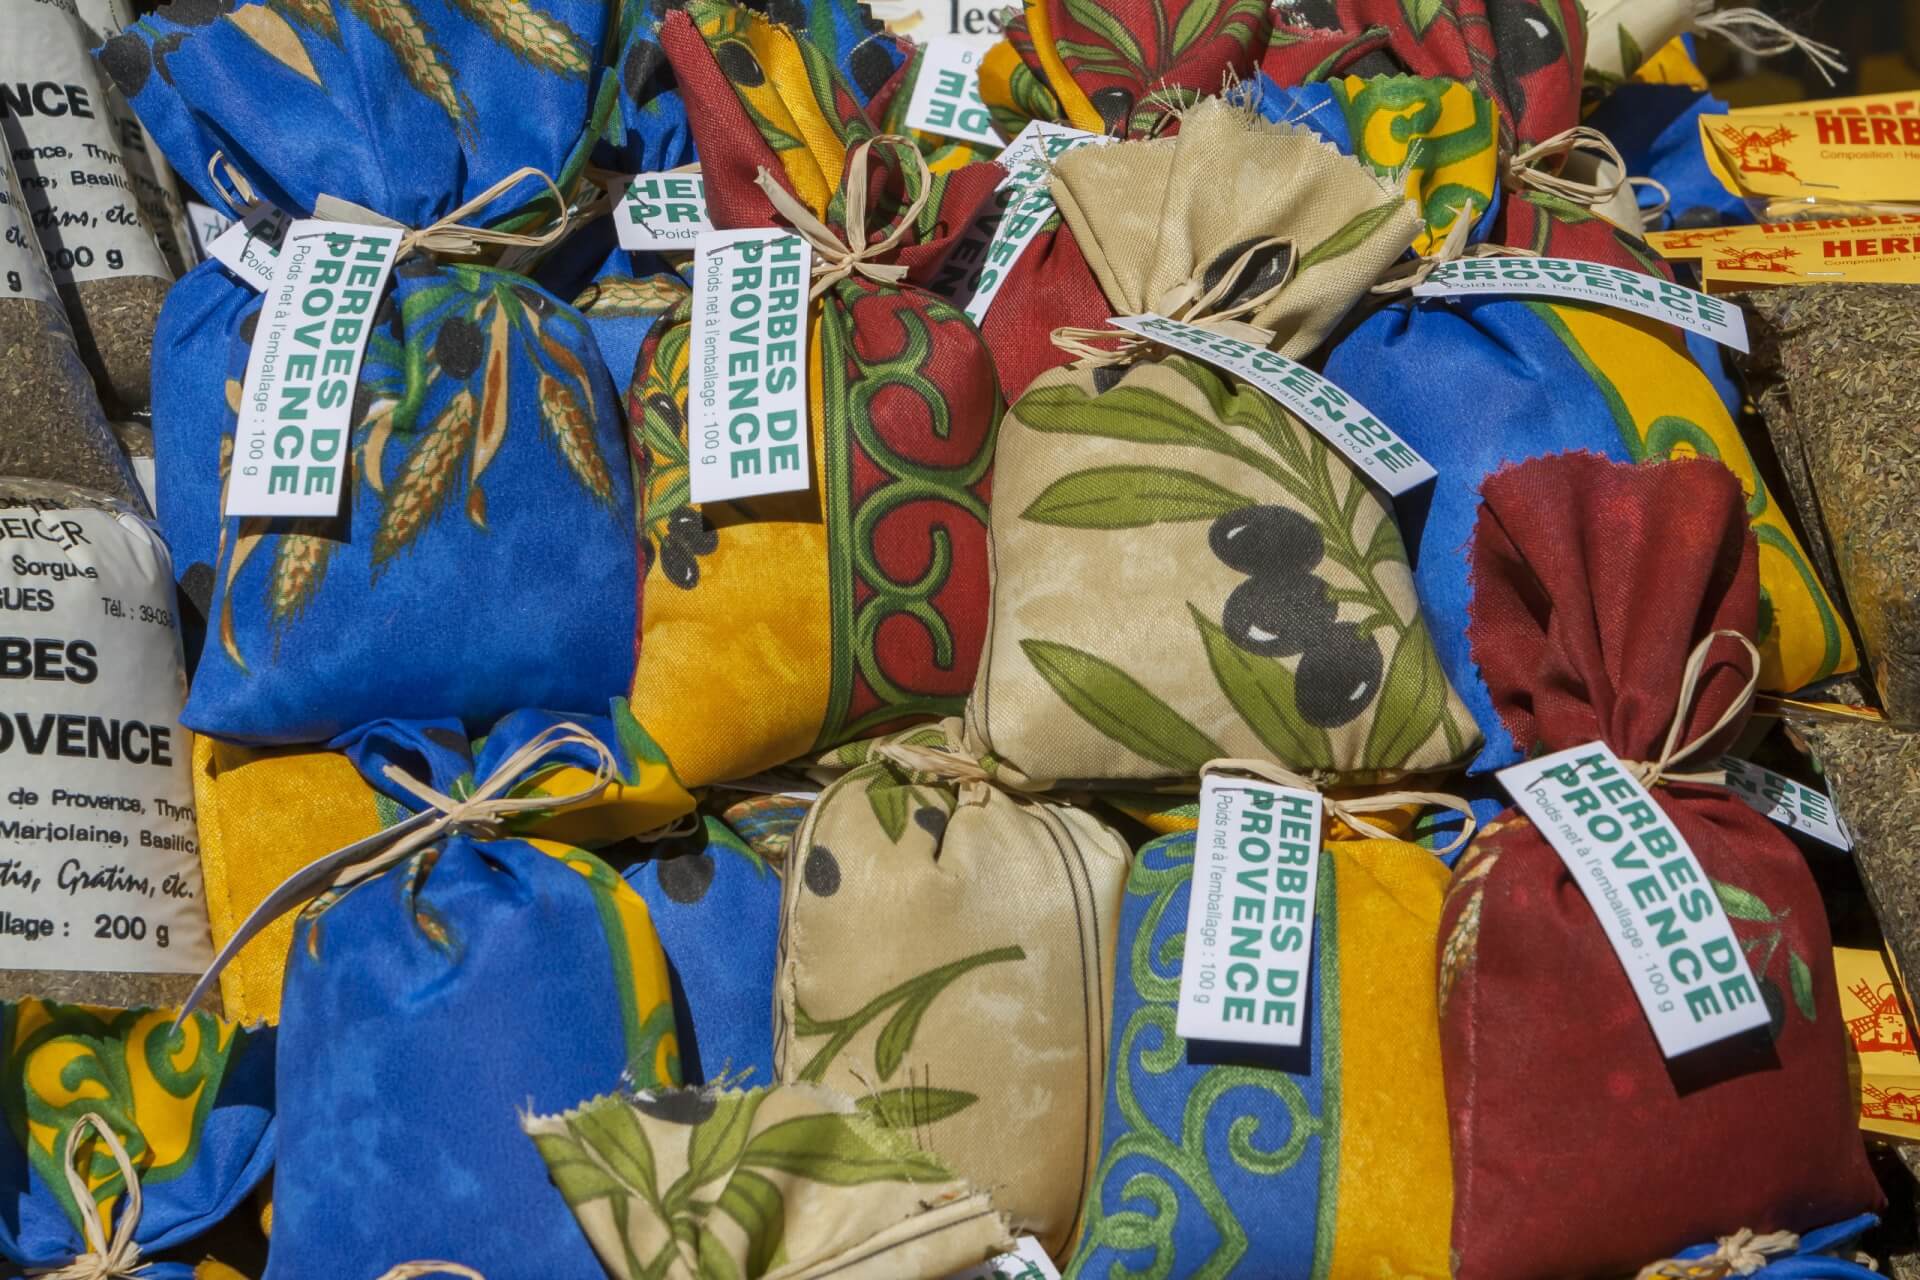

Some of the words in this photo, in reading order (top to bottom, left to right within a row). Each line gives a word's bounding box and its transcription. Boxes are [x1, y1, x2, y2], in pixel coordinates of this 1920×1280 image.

[925, 99, 991, 135] DE
[1820, 150, 1894, 160] Composition
[654, 228, 699, 239] Poids
[1823, 237, 1920, 258] HER
[105, 249, 124, 270] g
[243, 249, 275, 281] Poids
[287, 245, 311, 280] Poids
[708, 256, 723, 292] Poids
[1824, 256, 1902, 267] Composition
[6, 271, 22, 292] g
[279, 285, 295, 305] net
[1426, 269, 1728, 328] PROVENCE
[1441, 258, 1641, 287] HERBES
[1656, 282, 1727, 310] DE
[706, 294, 720, 313] net
[765, 236, 801, 394] HERBES
[1502, 281, 1529, 290] net
[1666, 309, 1697, 326] 100
[1701, 323, 1712, 333] g
[317, 235, 391, 409] HERBES
[253, 322, 286, 416] l'emballage
[267, 232, 354, 494] PROVENCE
[700, 329, 720, 408] l'emballage
[728, 239, 764, 479] PROVENCE
[250, 430, 264, 460] 100
[704, 420, 719, 449] 100
[767, 409, 800, 475] DE
[1359, 416, 1420, 467] DE
[243, 466, 258, 476] g
[304, 428, 341, 496] DE
[702, 454, 717, 465] g
[101, 597, 126, 618] Tél.
[8, 787, 39, 806] de
[52, 789, 146, 815] Provence,
[1215, 794, 1234, 828] Poids
[1214, 830, 1228, 850] net
[57, 858, 157, 898] Gratins,
[162, 872, 194, 899] etc.
[1269, 794, 1313, 953] HERBES
[1575, 753, 1713, 924] HERBES
[1701, 936, 1757, 1011] DE
[1202, 865, 1225, 949] l'emballage
[1222, 788, 1275, 1023] PROVENCE
[1531, 787, 1562, 823] Poids
[1559, 821, 1584, 845] net
[1587, 857, 1645, 950] l'emballage
[1643, 962, 1670, 996] 100
[1657, 1000, 1675, 1014] g
[1541, 762, 1723, 1024] PROVENCE
[94, 914, 147, 940] 200
[155, 924, 169, 948] g
[1199, 963, 1217, 991] 100
[1193, 995, 1210, 1005] g
[1262, 968, 1300, 1027] DE
